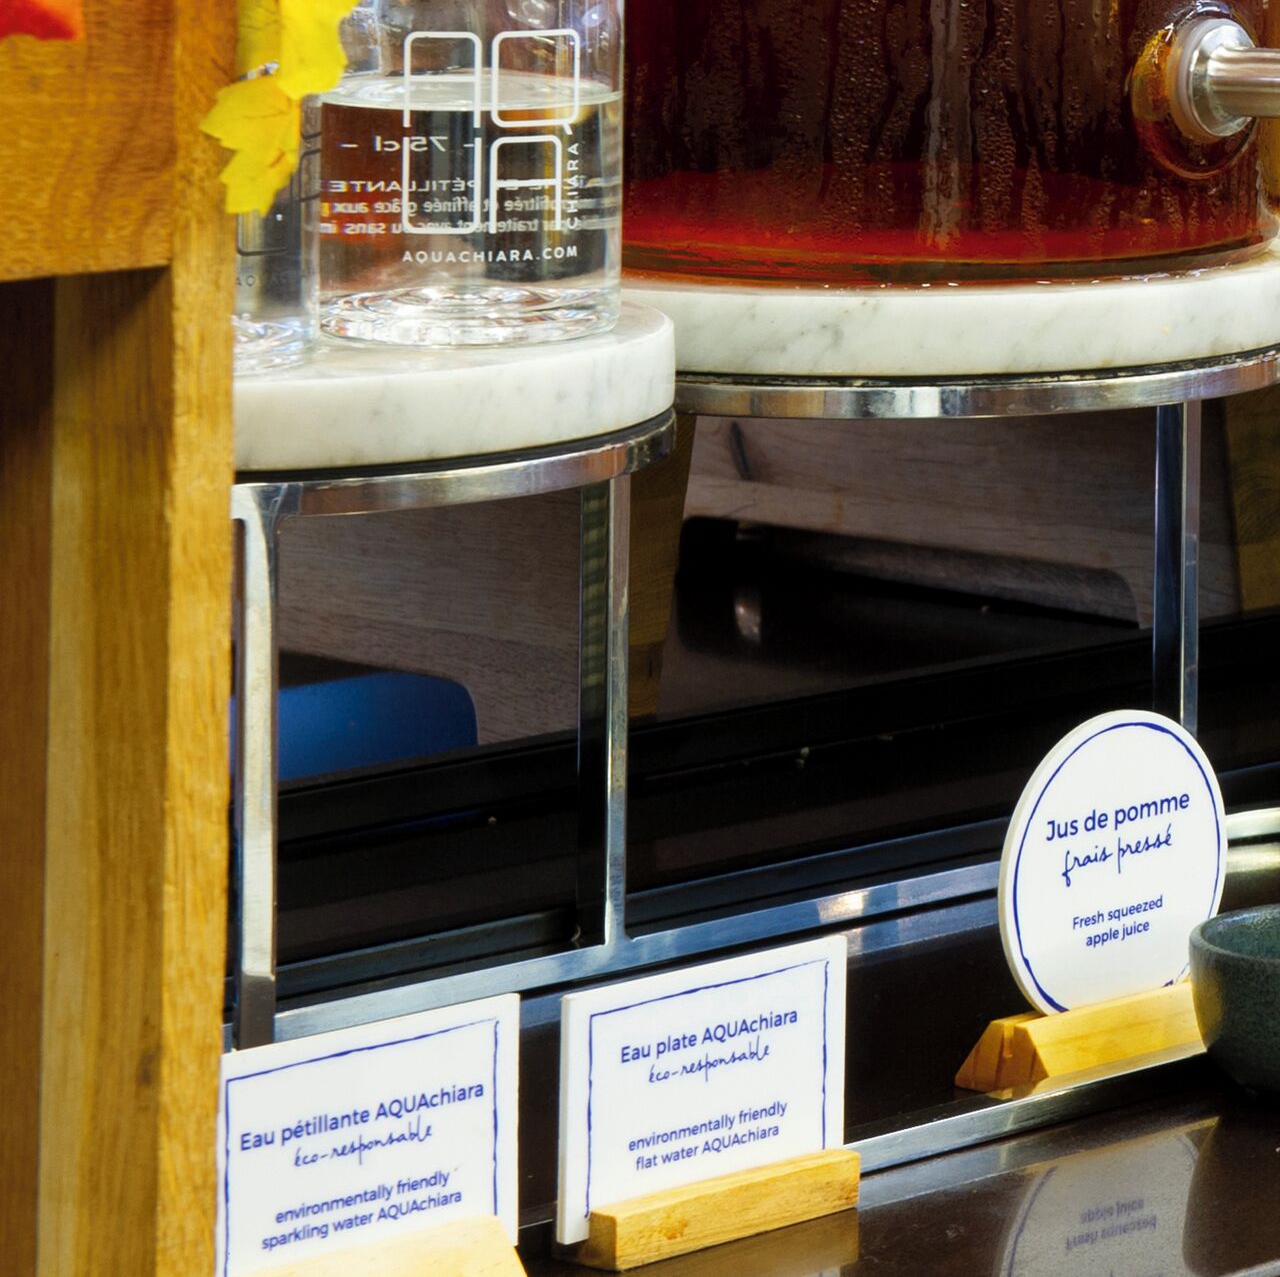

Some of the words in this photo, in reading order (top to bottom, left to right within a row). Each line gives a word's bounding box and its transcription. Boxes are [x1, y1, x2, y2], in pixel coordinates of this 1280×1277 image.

[566, 141, 582, 230] CHIARA
[402, 245, 577, 265] AQUACHIARA.COM
[1045, 819, 1079, 843] Jus
[1083, 807, 1109, 830] de
[1114, 792, 1191, 830] pomme
[1061, 845, 1113, 888] frais
[1117, 822, 1173, 874] pressé
[1072, 909, 1105, 931] Fresh
[1107, 895, 1164, 923] squeezed
[1085, 925, 1120, 948] apple
[1120, 919, 1150, 944] juice
[620, 1044, 652, 1064] Eau
[656, 1033, 698, 1060] plate
[701, 1010, 798, 1045] AQUAchiara
[648, 1034, 771, 1084] éco-responsable
[240, 1130, 275, 1152] Eau
[280, 1108, 371, 1147] pétillante
[374, 1082, 485, 1121] AQUAchiara
[293, 1114, 433, 1167] éco-responsable
[628, 1113, 736, 1152] environmentally
[738, 1100, 788, 1125] friendly
[635, 1155, 658, 1171] flat
[660, 1145, 700, 1165] water
[701, 1125, 780, 1154] AQUAchiara
[261, 1222, 330, 1252] sparkling
[331, 1211, 374, 1233] water
[376, 1190, 463, 1223] AQUAchiara
[275, 1182, 394, 1225] environmentally
[396, 1169, 450, 1195] friendly
